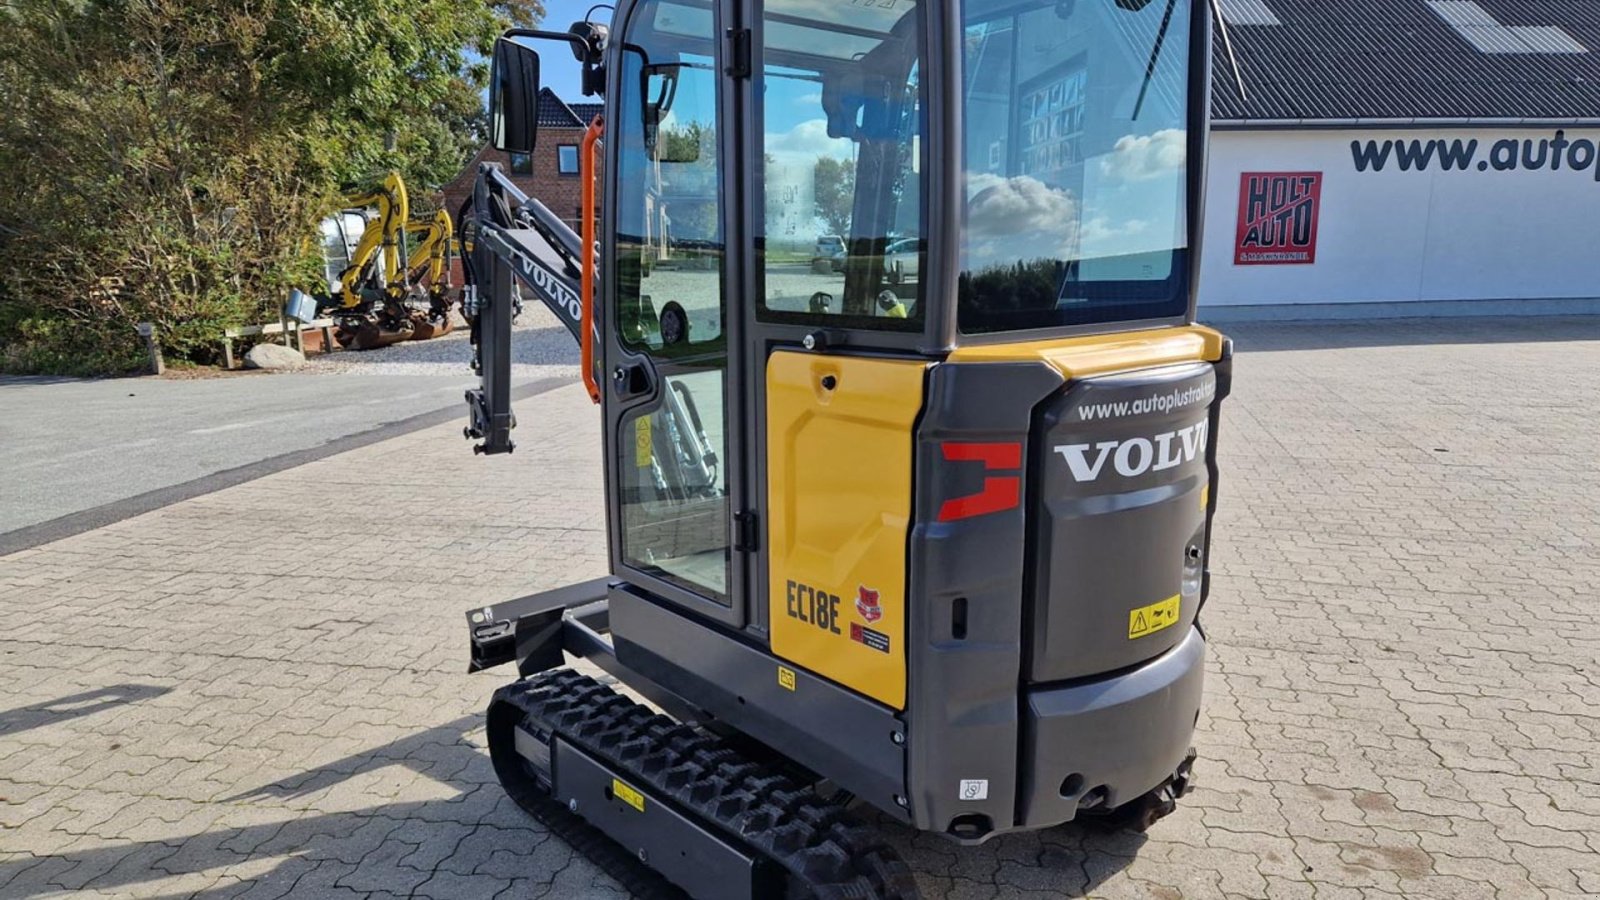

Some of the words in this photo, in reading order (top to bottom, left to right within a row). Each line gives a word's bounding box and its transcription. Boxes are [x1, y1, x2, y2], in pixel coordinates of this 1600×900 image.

[1241, 198, 1313, 248] AUTO
[1246, 176, 1316, 225] HOLT
[519, 252, 582, 321] VOLVO
[1054, 416, 1209, 482] VOLVO
[787, 579, 841, 635] EC18E
